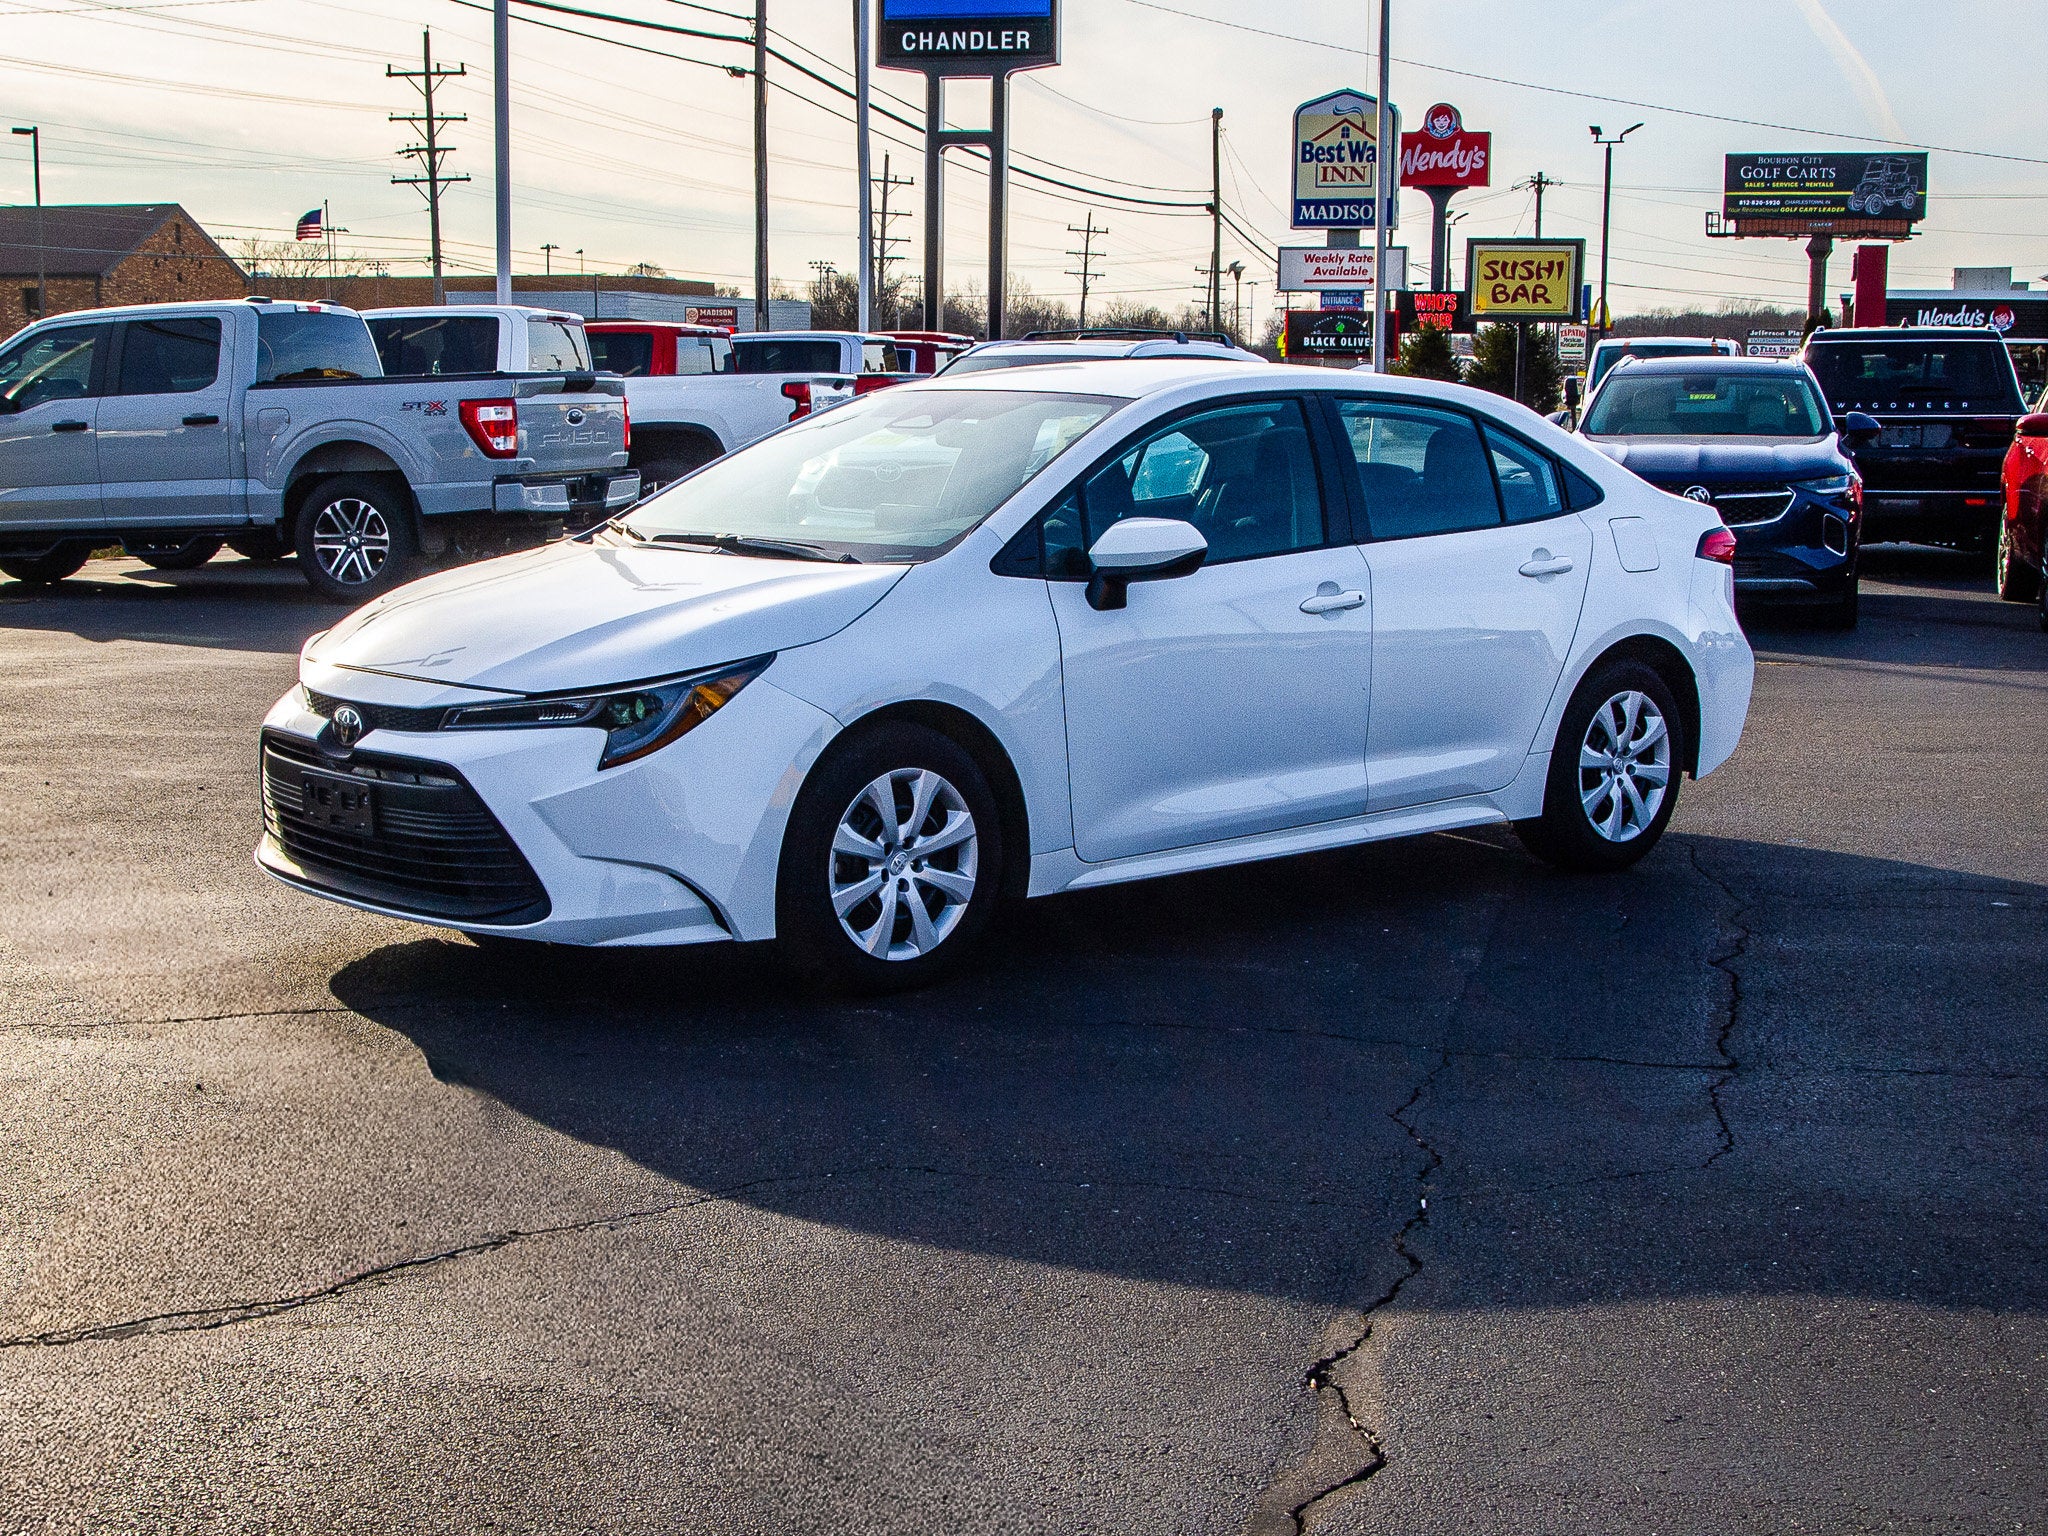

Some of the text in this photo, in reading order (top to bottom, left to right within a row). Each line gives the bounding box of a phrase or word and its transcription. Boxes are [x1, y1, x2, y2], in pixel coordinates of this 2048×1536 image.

[901, 30, 1030, 51] CHANDLER
[1300, 140, 1377, 163] Best Wa
[1400, 139, 1486, 178] Wendy's
[1758, 156, 1823, 164] BOURBON CITY
[1320, 165, 1367, 183] INN
[1740, 165, 1836, 179] GOLF CARTS
[1299, 205, 1376, 220] MADISO
[1304, 253, 1375, 265] Weekly Rate
[1313, 266, 1369, 276] Available
[1484, 259, 1565, 281] SUSHI
[1321, 296, 1353, 305] ENTRANCE
[1414, 293, 1457, 312] WHO'S
[1491, 283, 1552, 304] BAR
[1917, 304, 1985, 327] Wendy's
[1303, 336, 1336, 347] BLACK
[400, 400, 448, 411] STX
[540, 429, 610, 447] F-150
